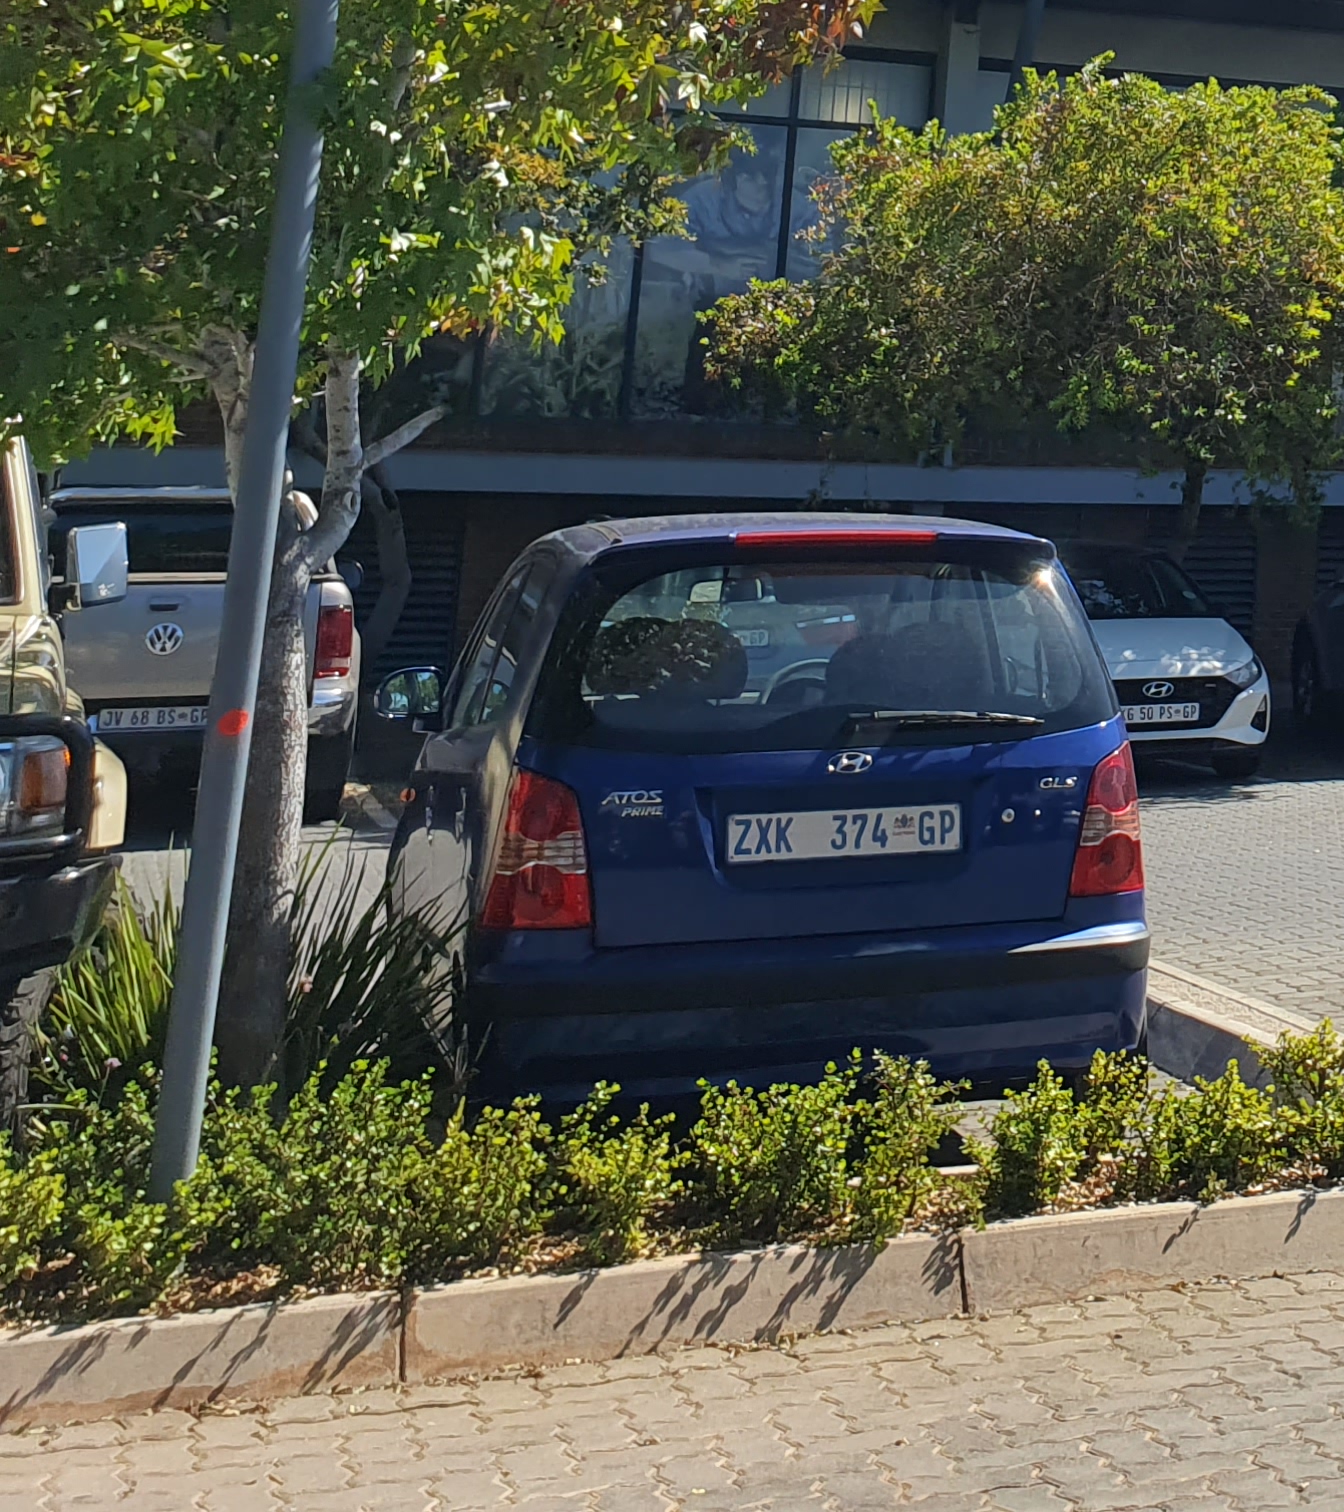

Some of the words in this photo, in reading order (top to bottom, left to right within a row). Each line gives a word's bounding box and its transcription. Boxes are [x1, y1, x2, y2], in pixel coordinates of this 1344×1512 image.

[103, 711, 123, 727] JV
[130, 710, 149, 725] 68
[157, 709, 175, 725] BS
[1139, 706, 1153, 720] 50
[1159, 706, 1173, 719] PS
[1182, 705, 1197, 718] GP
[1039, 776, 1077, 789] GLS
[601, 790, 663, 805] ATOS
[621, 806, 664, 817] PRIME
[733, 817, 794, 856] ZXK
[830, 813, 889, 850] 374
[918, 810, 955, 846] GP
